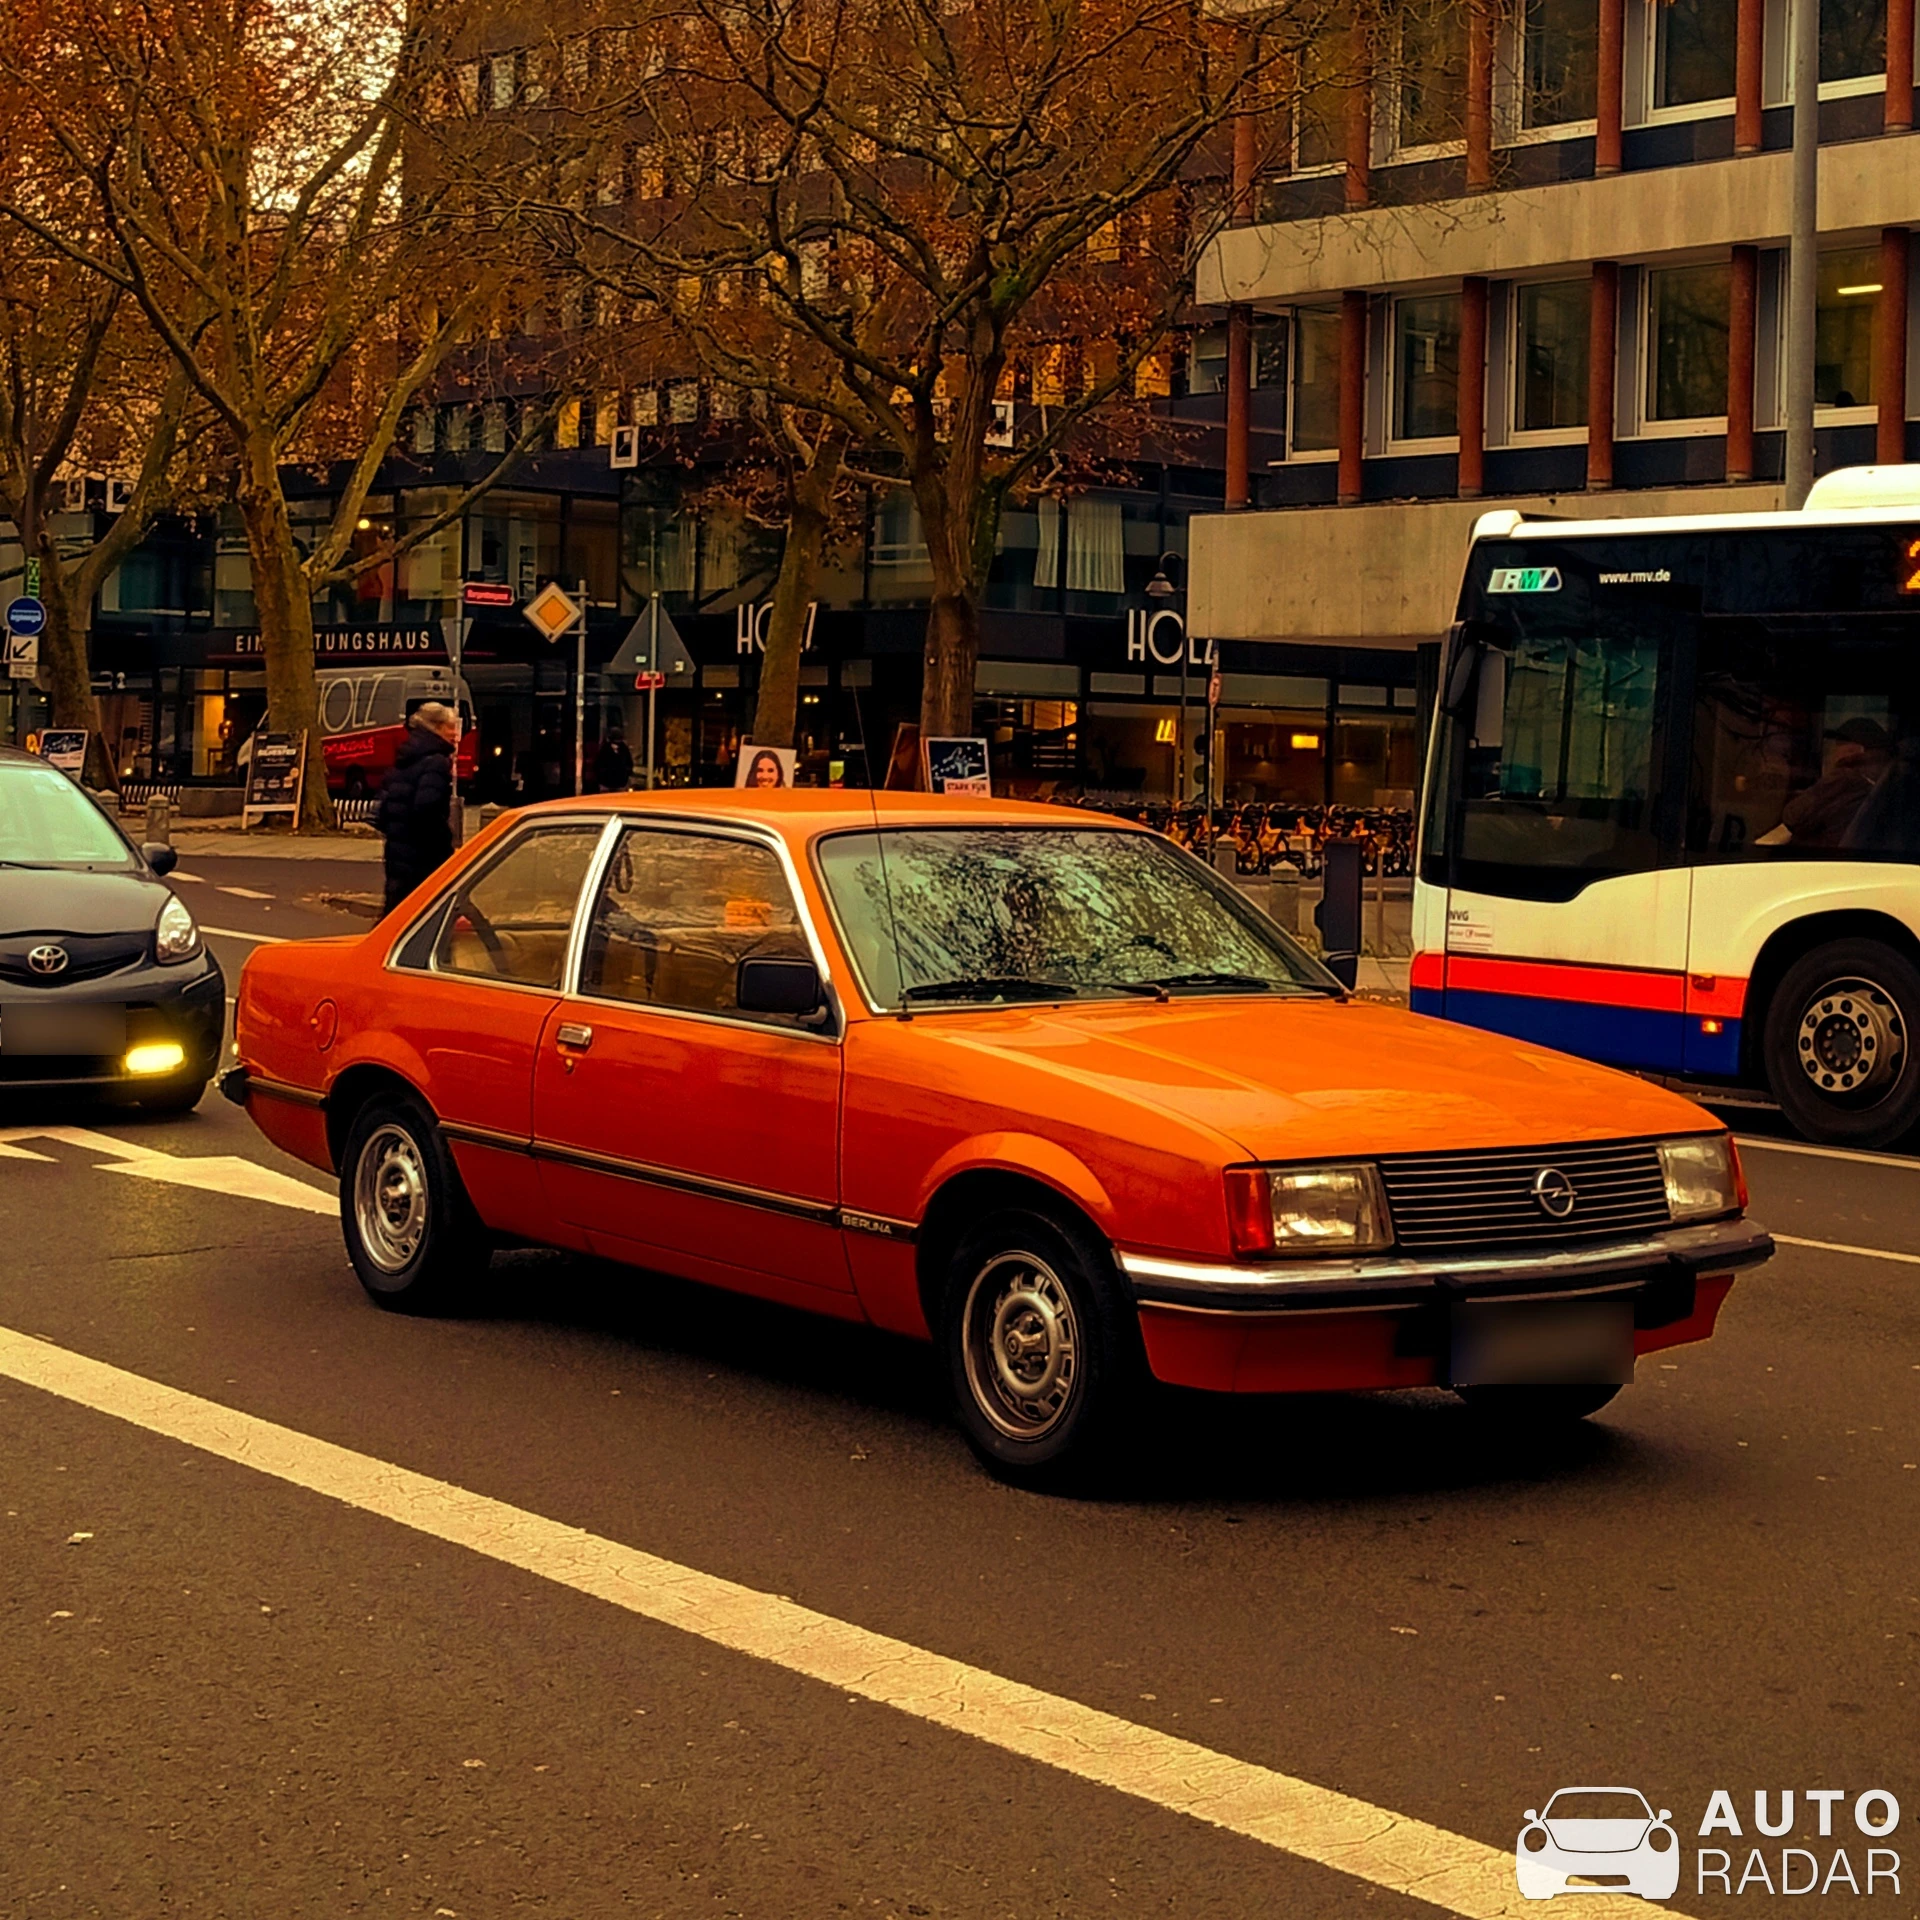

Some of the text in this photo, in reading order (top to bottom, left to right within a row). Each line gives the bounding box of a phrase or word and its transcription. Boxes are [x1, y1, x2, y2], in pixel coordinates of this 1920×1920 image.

[1495, 567, 1560, 592] RMV
[1598, 569, 1672, 584] www.rmv.de
[235, 630, 430, 653] EINTUNGSHAUS
[318, 672, 386, 733] OLZ
[842, 1215, 892, 1233] BERLINA
